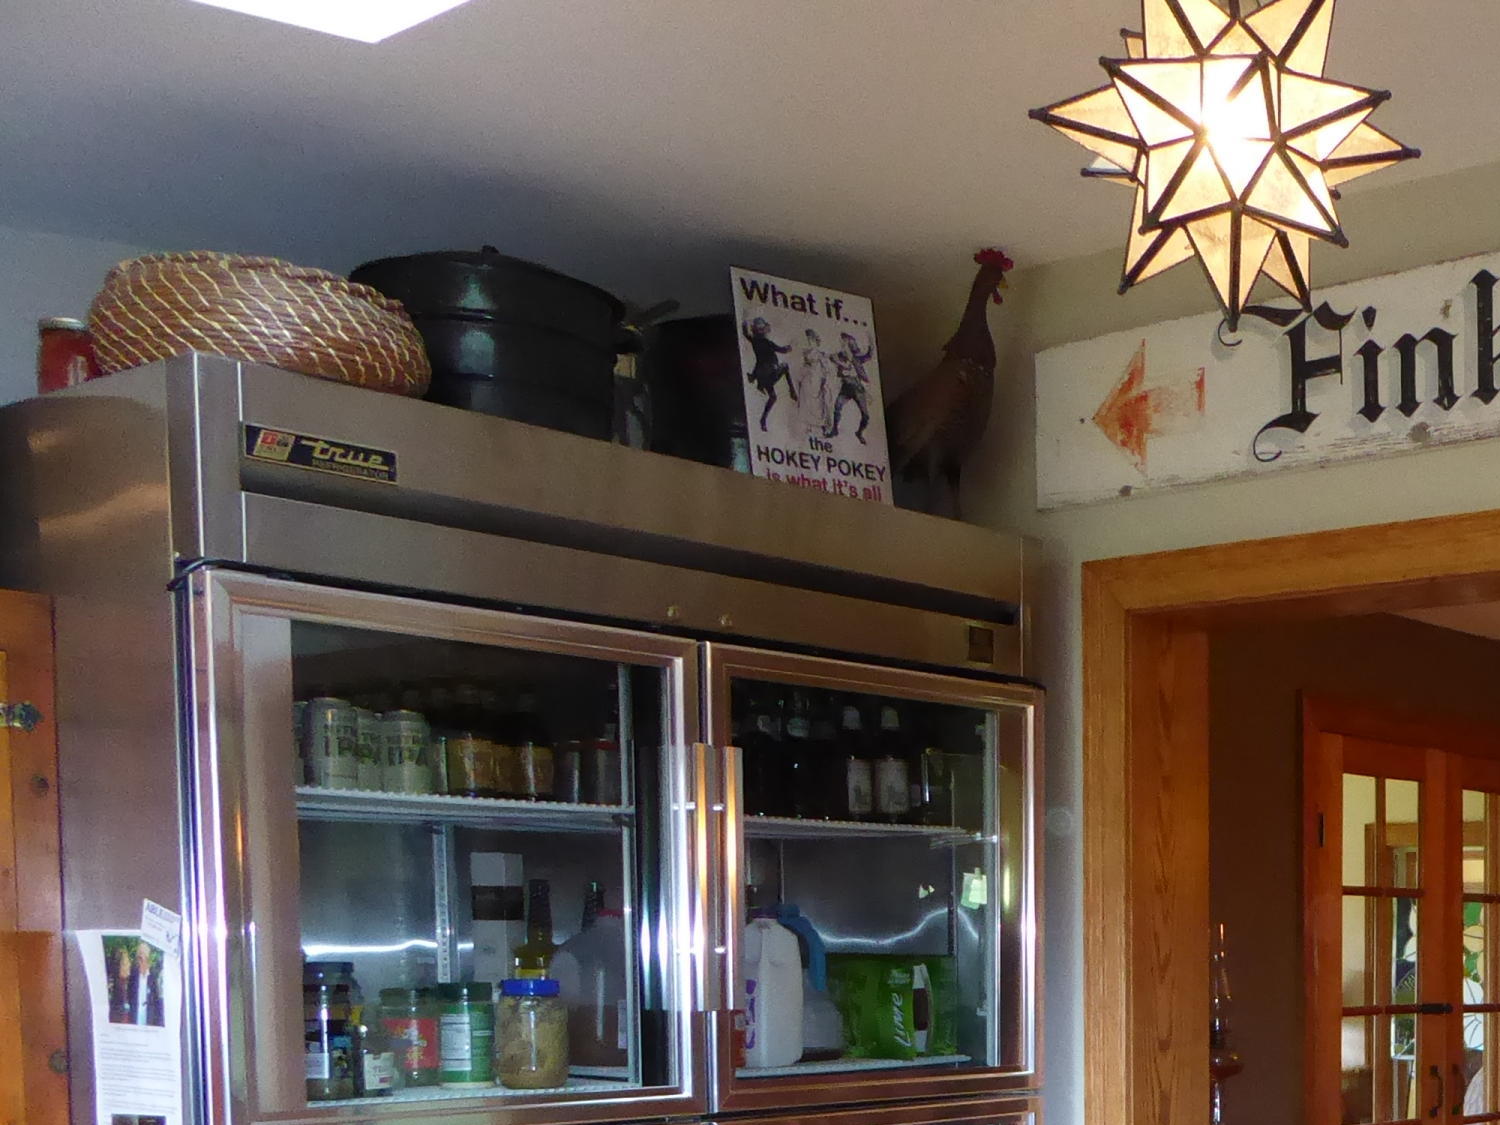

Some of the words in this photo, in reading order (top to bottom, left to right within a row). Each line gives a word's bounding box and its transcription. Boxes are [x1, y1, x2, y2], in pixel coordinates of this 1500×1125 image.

[739, 277, 819, 316] What
[825, 296, 868, 327] if...
[808, 436, 833, 454] the
[756, 444, 821, 473] HOKEY
[826, 456, 886, 482] POKEY
[786, 472, 828, 493] what
